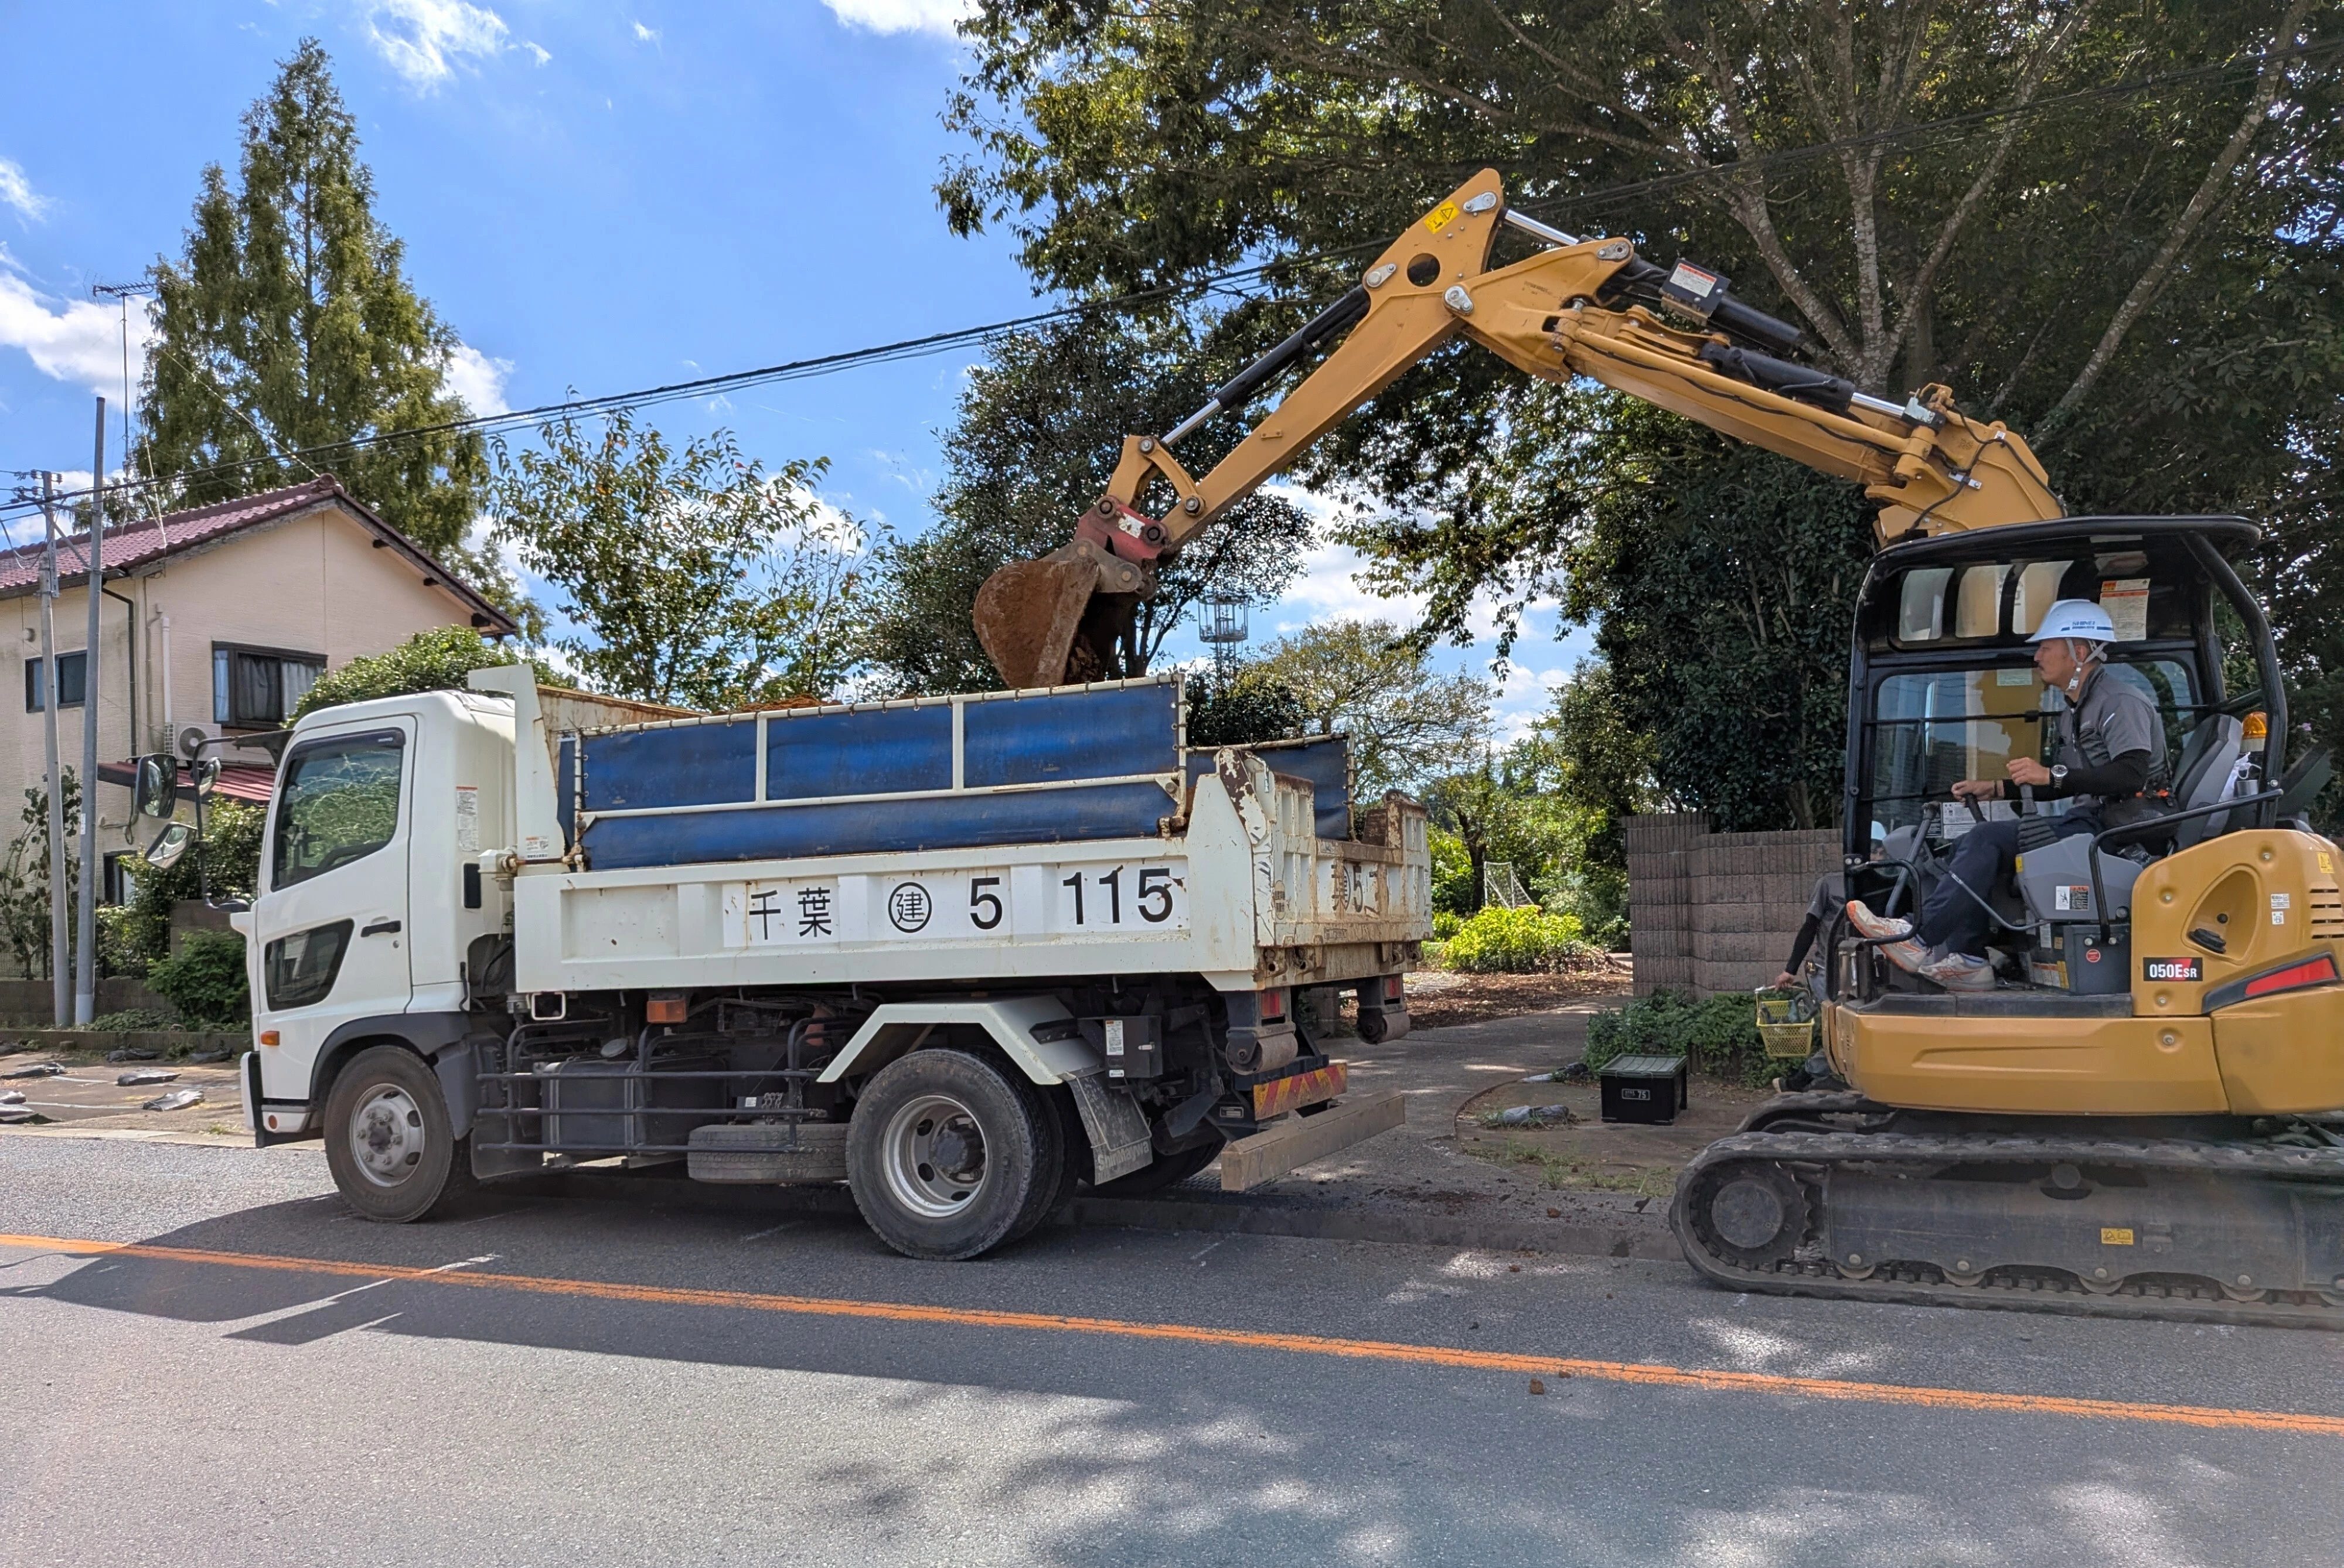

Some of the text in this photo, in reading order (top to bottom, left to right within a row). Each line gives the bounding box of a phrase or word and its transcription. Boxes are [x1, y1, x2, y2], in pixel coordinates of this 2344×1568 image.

[749, 887, 832, 940] 千葉
[970, 877, 1003, 930] 5
[1062, 867, 1173, 925] 115
